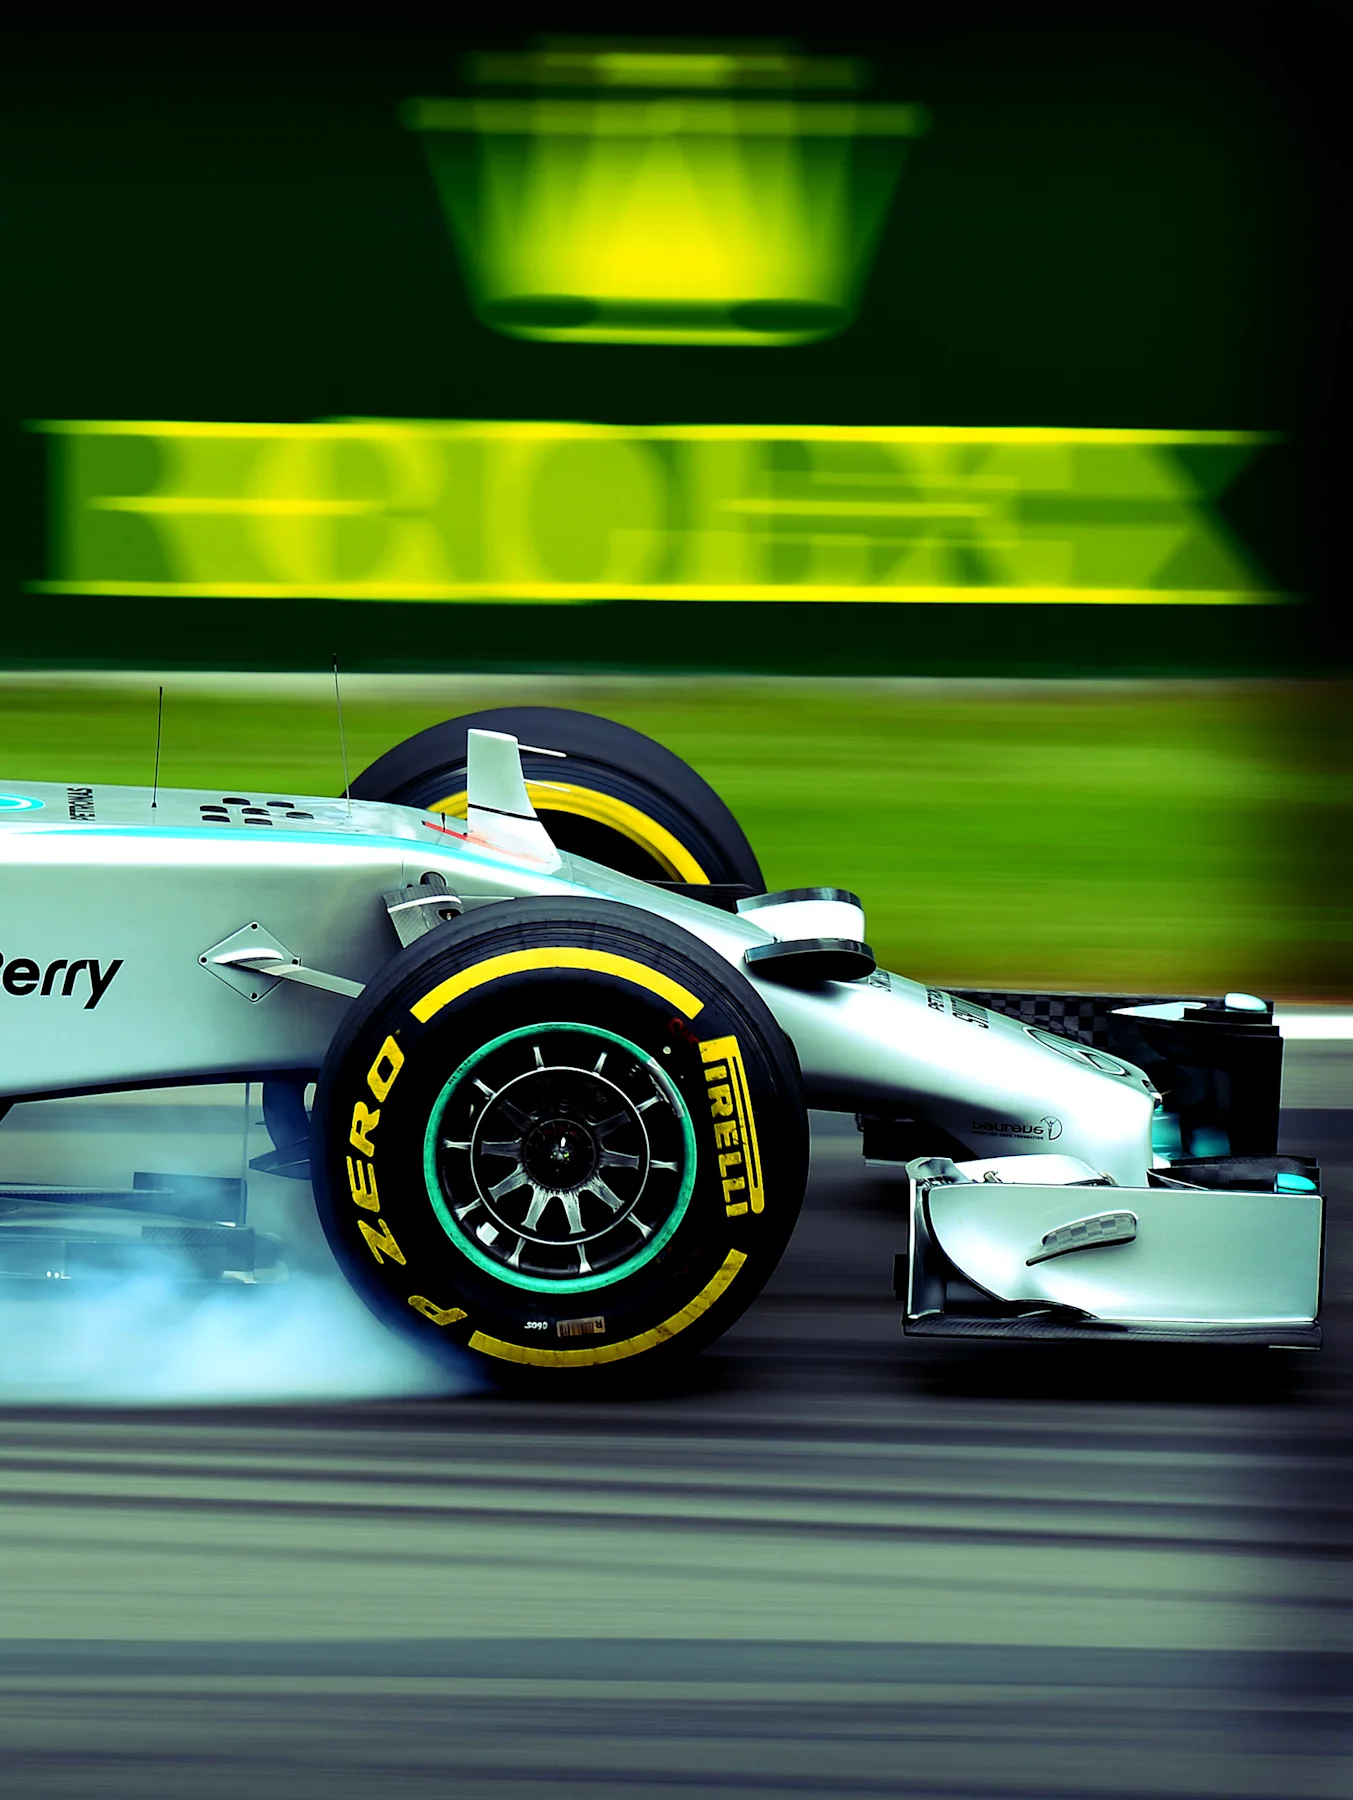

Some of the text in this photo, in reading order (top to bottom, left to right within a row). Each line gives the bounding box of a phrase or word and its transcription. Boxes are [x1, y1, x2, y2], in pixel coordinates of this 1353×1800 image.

[66, 788, 95, 822] PETRONAS
[346, 1035, 406, 1266] ZERO
[699, 1035, 765, 1218] PIRELLI
